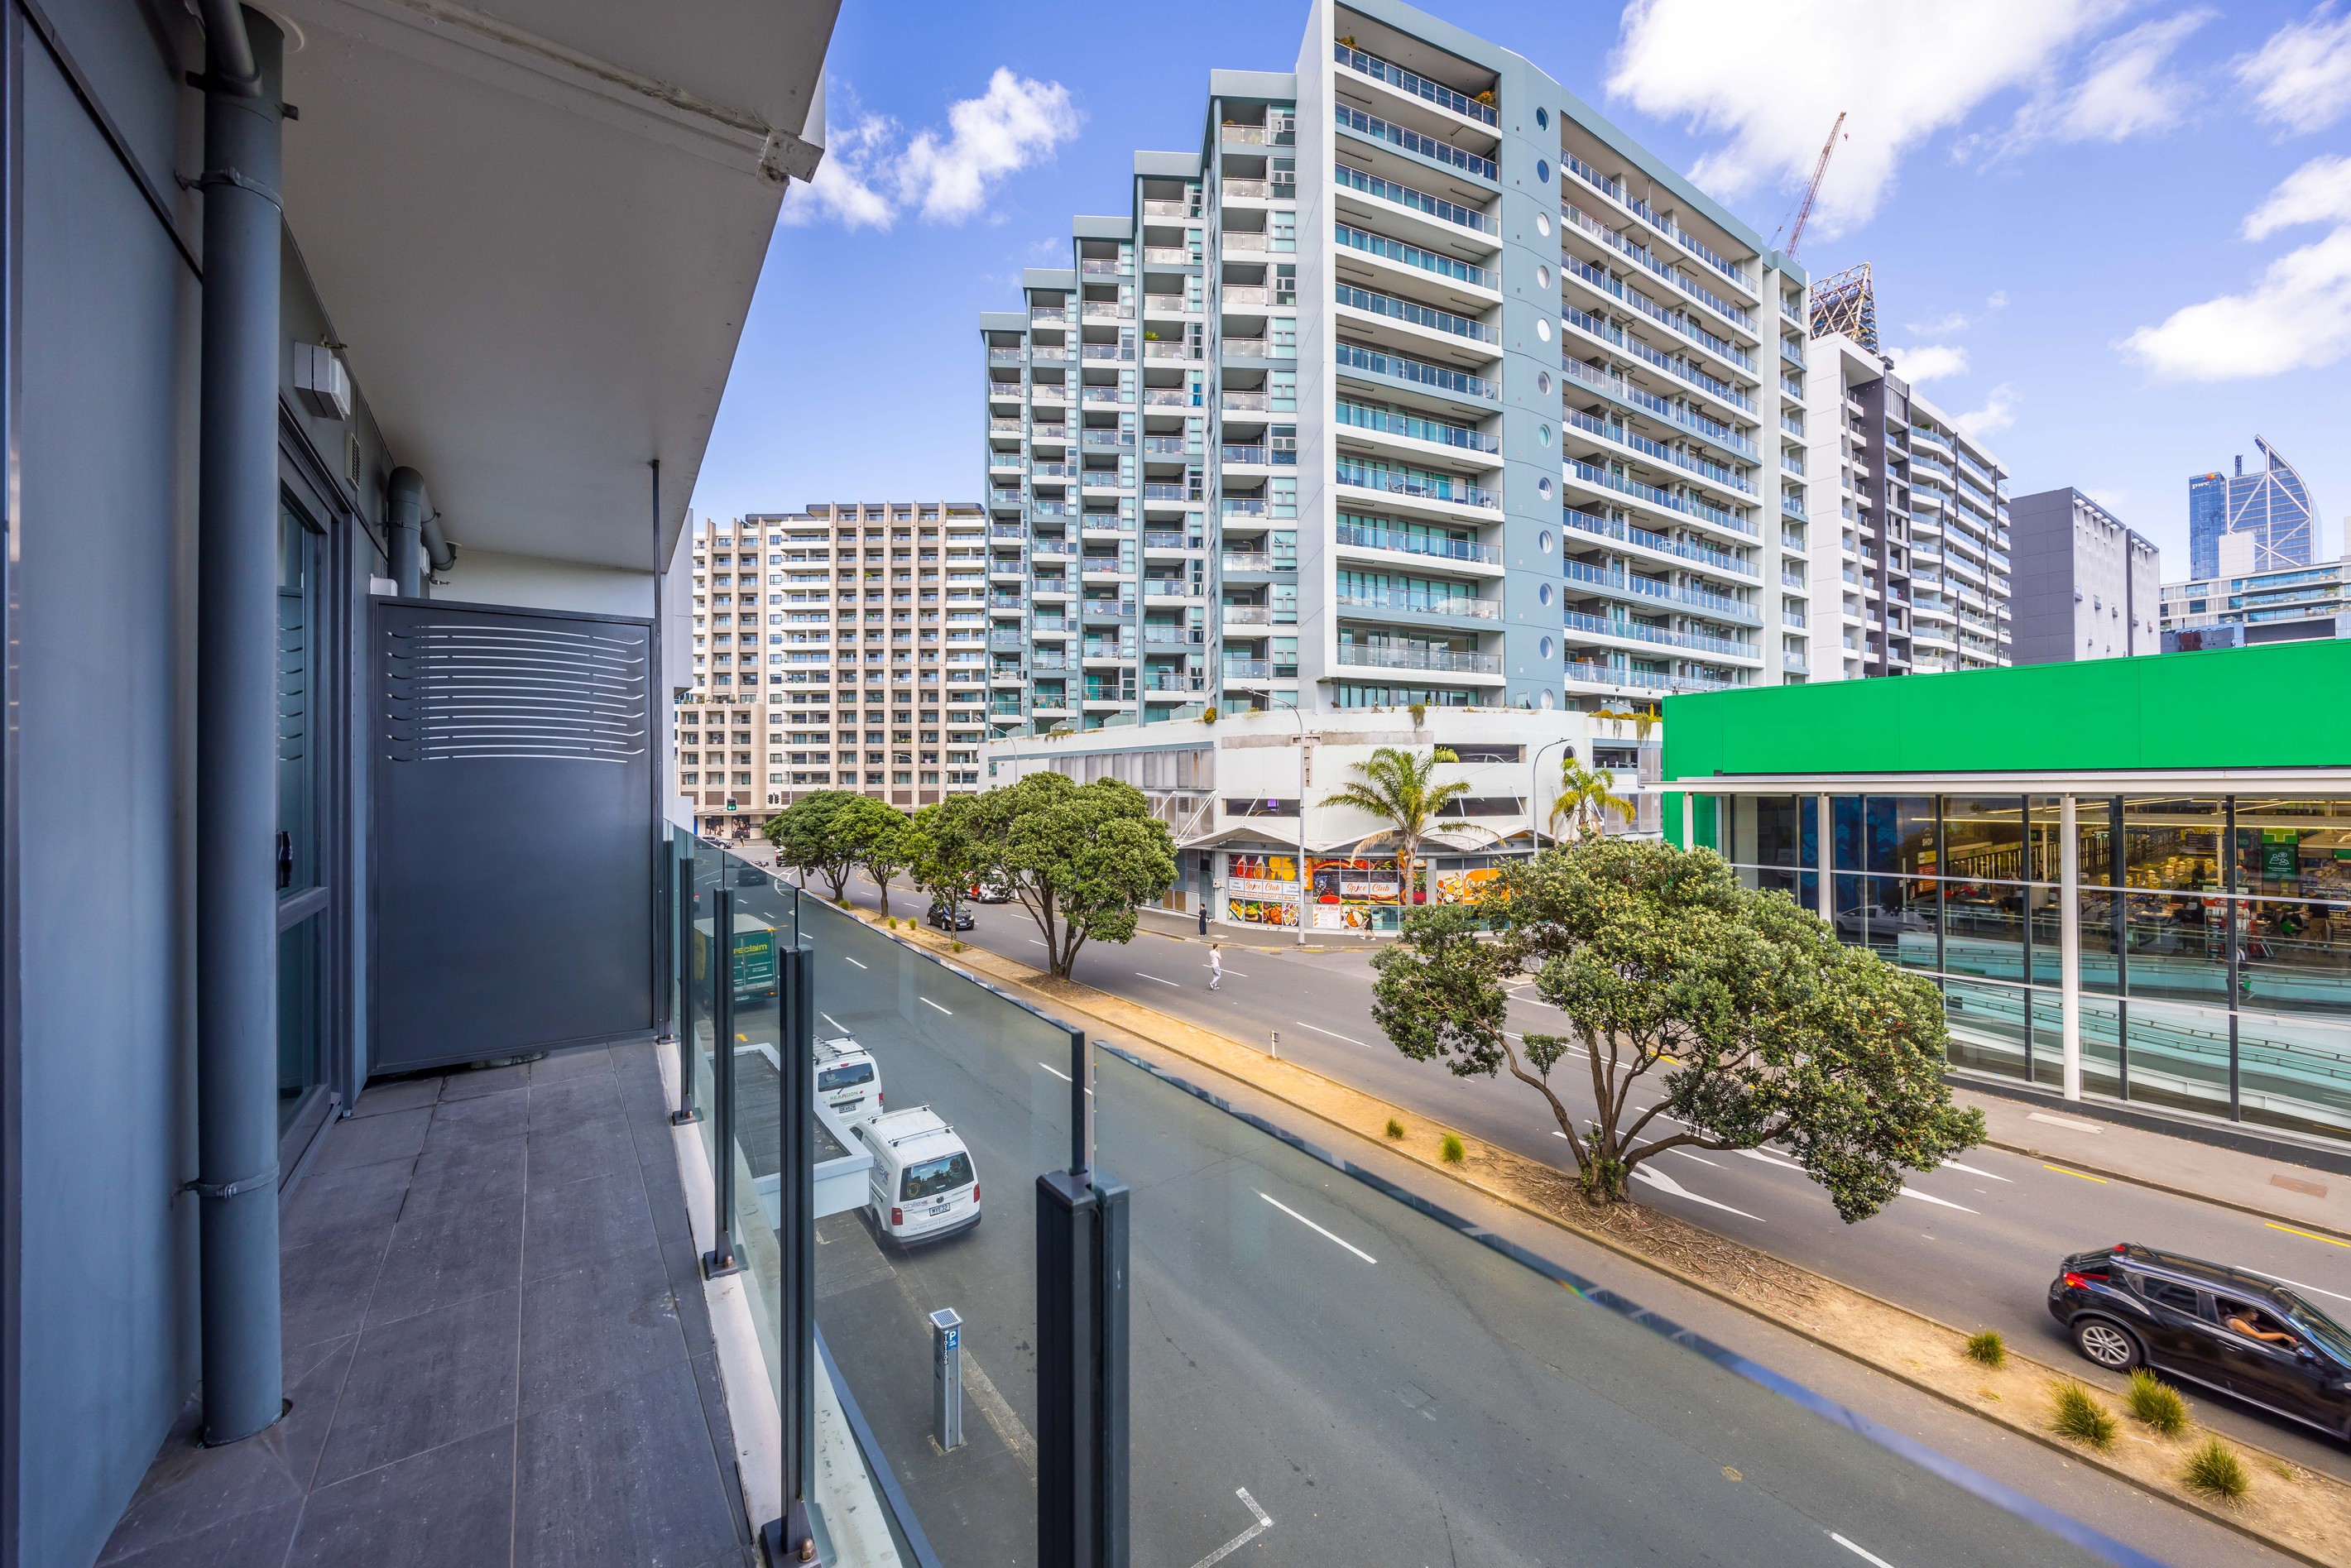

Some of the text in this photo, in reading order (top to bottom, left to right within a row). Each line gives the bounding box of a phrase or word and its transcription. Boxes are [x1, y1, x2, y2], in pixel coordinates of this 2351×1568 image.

[1245, 881, 1280, 891] Spice Club
[1346, 883, 1390, 892] Spice Club
[733, 944, 767, 954] reclaim
[830, 1091, 858, 1100] REARDON
[949, 1331, 957, 1340] P
